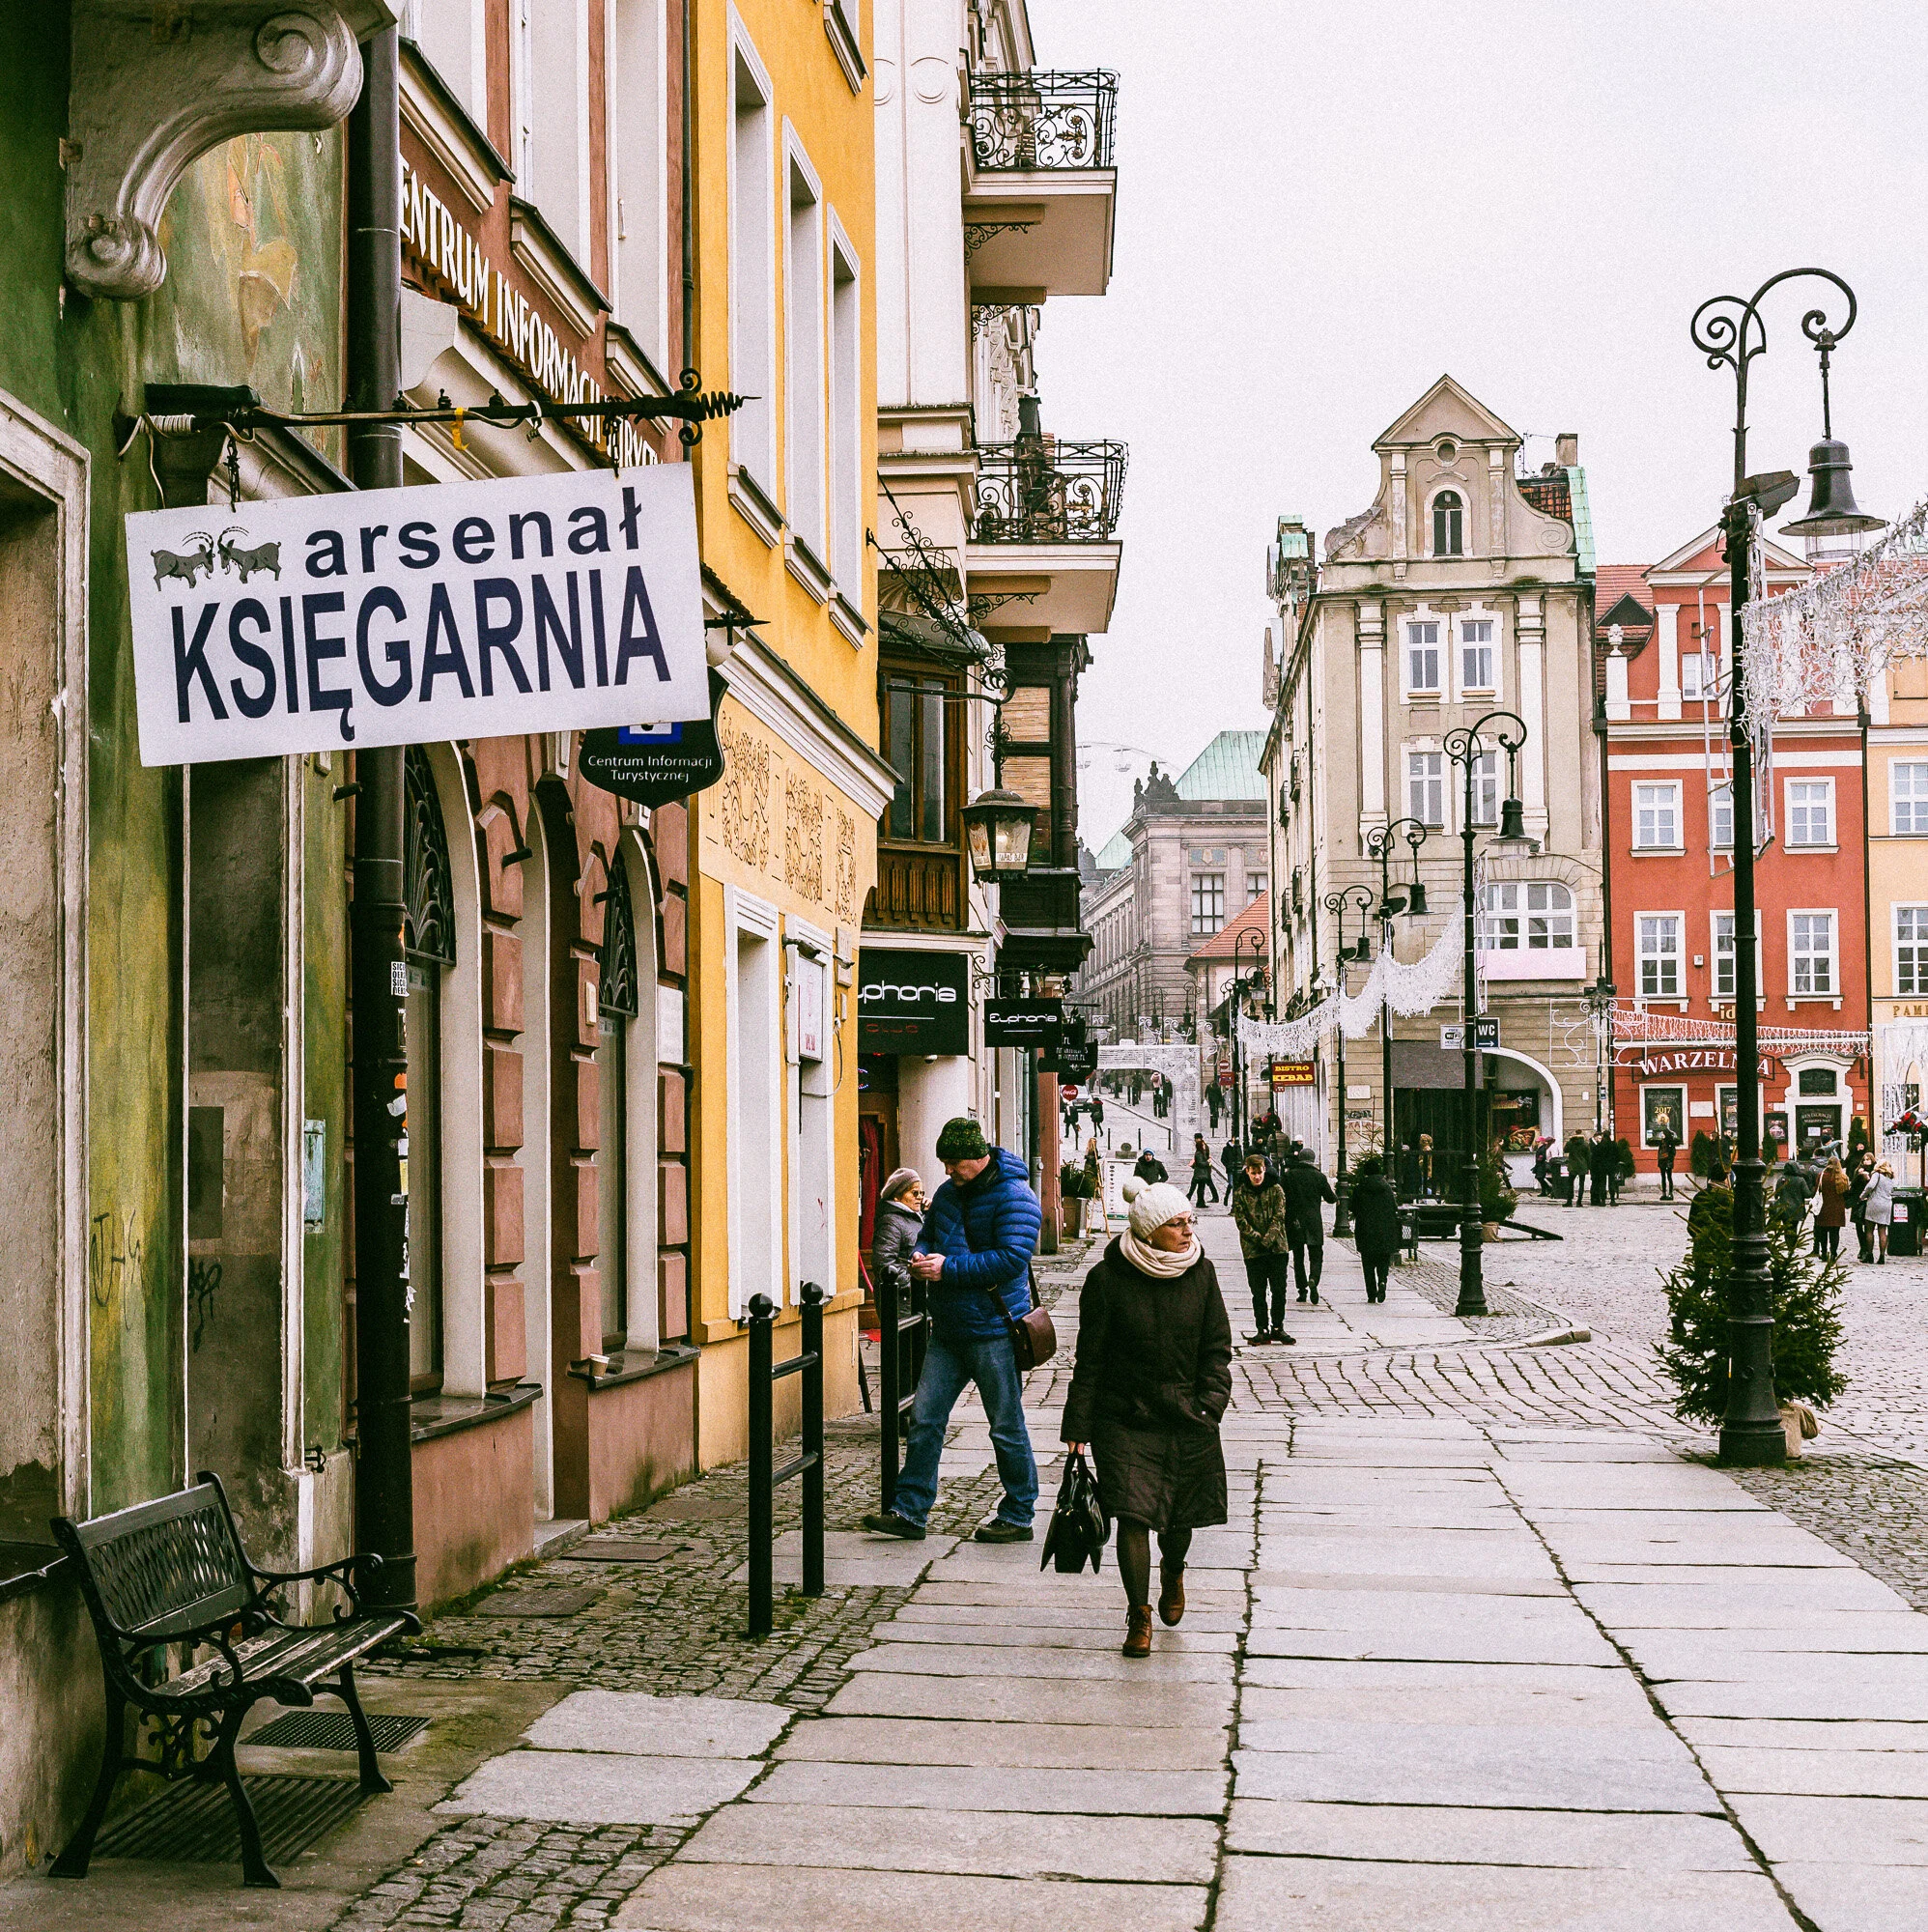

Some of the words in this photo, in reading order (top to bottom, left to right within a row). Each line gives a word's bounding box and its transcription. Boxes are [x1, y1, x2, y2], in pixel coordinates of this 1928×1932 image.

[398, 152, 489, 327] ENTRUM
[304, 486, 642, 579] arsenał
[171, 565, 672, 742] KSIĘGARNIA
[588, 755, 643, 767] Centrum
[648, 754, 712, 769] Informacji
[610, 770, 689, 782] Turystycznej
[857, 980, 956, 1004] uphoria
[989, 1012, 1058, 1024] Euphoria
[1719, 1005, 1737, 1020] id
[1478, 1024, 1495, 1036] WC
[1638, 1051, 1770, 1075] WARZELA
